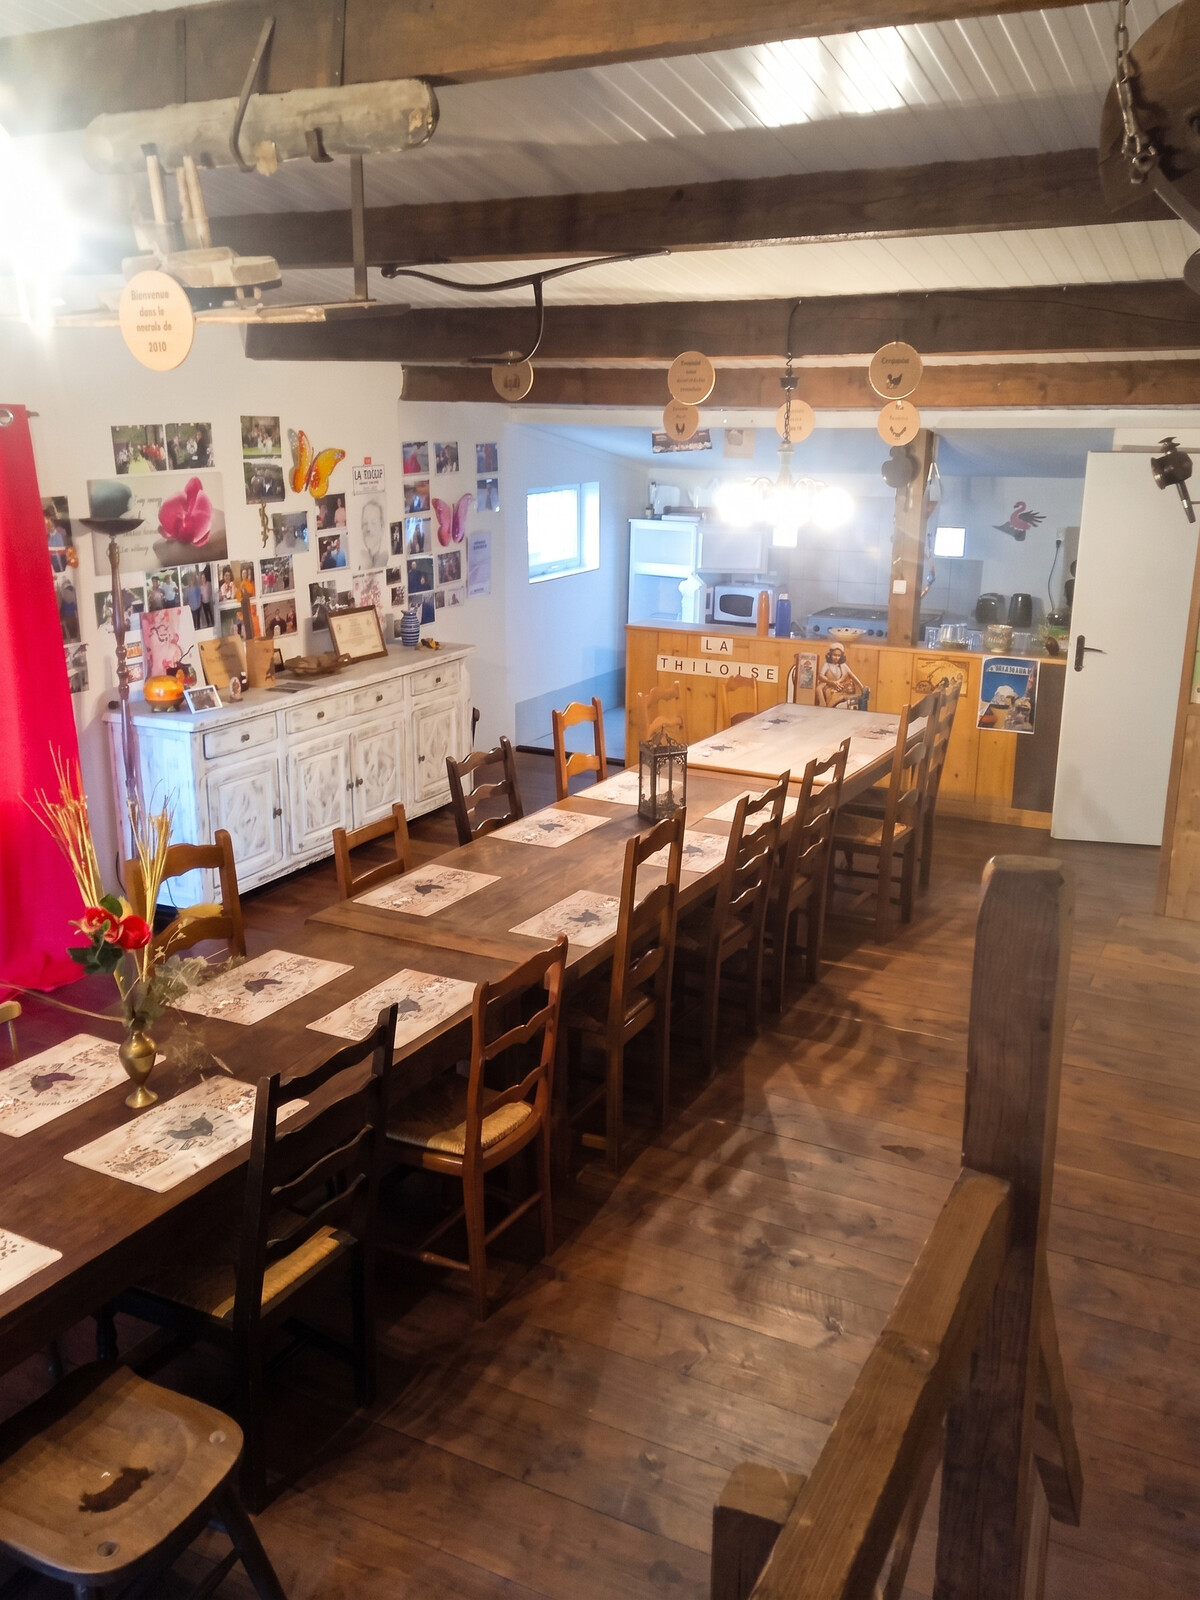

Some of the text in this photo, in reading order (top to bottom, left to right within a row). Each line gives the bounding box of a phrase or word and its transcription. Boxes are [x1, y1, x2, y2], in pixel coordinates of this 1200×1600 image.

[131, 290, 169, 301] Bienvenue
[139, 306, 157, 317] dans
[148, 341, 167, 353] 2010
[705, 639, 728, 652] LA
[660, 657, 775, 680] THILOISE
